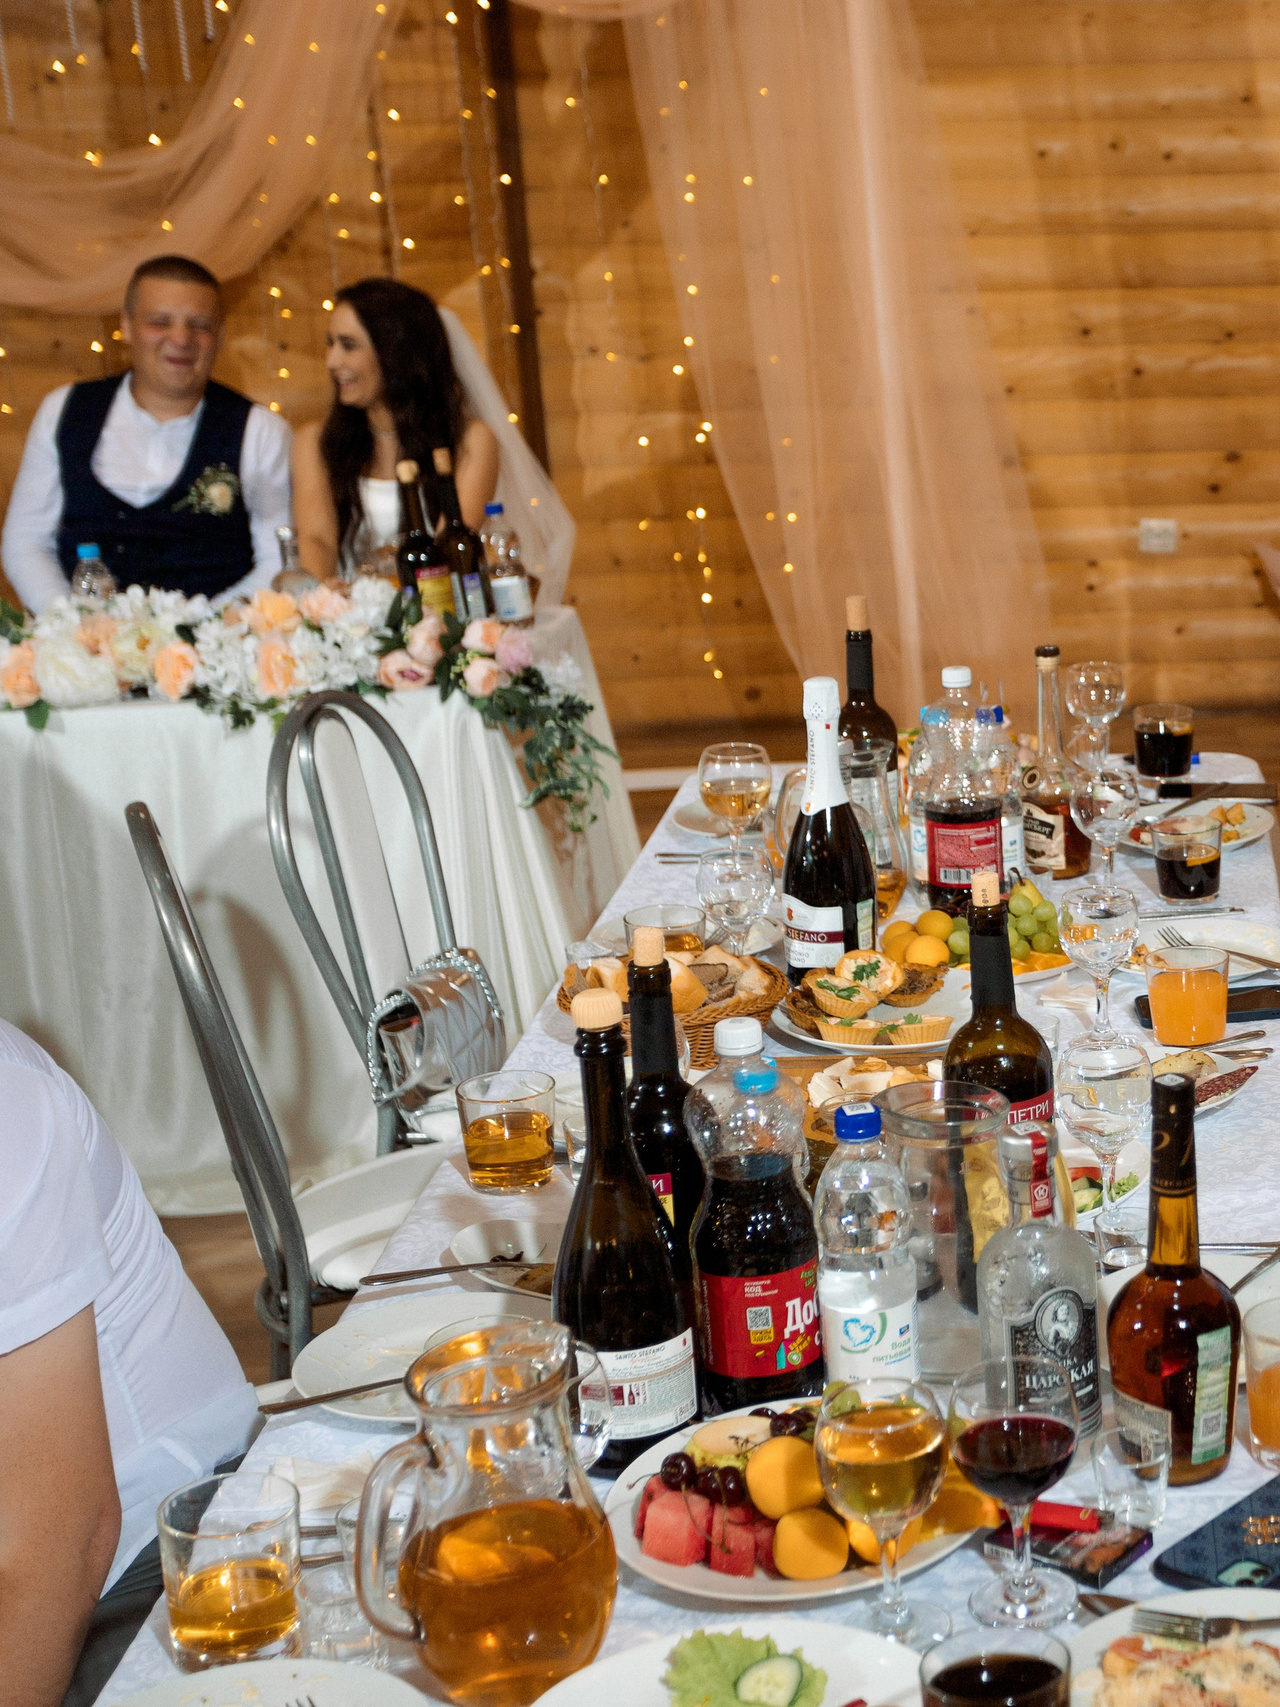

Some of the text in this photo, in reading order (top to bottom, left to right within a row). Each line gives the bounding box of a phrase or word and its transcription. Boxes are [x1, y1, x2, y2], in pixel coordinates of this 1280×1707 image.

[787, 928, 827, 943] STEFANO
[1007, 1100, 1049, 1125] ПЕТРИ
[744, 1285, 762, 1293] КОД
[891, 1338, 911, 1350] Вода
[615, 1345, 665, 1360] SANTO STEFANO
